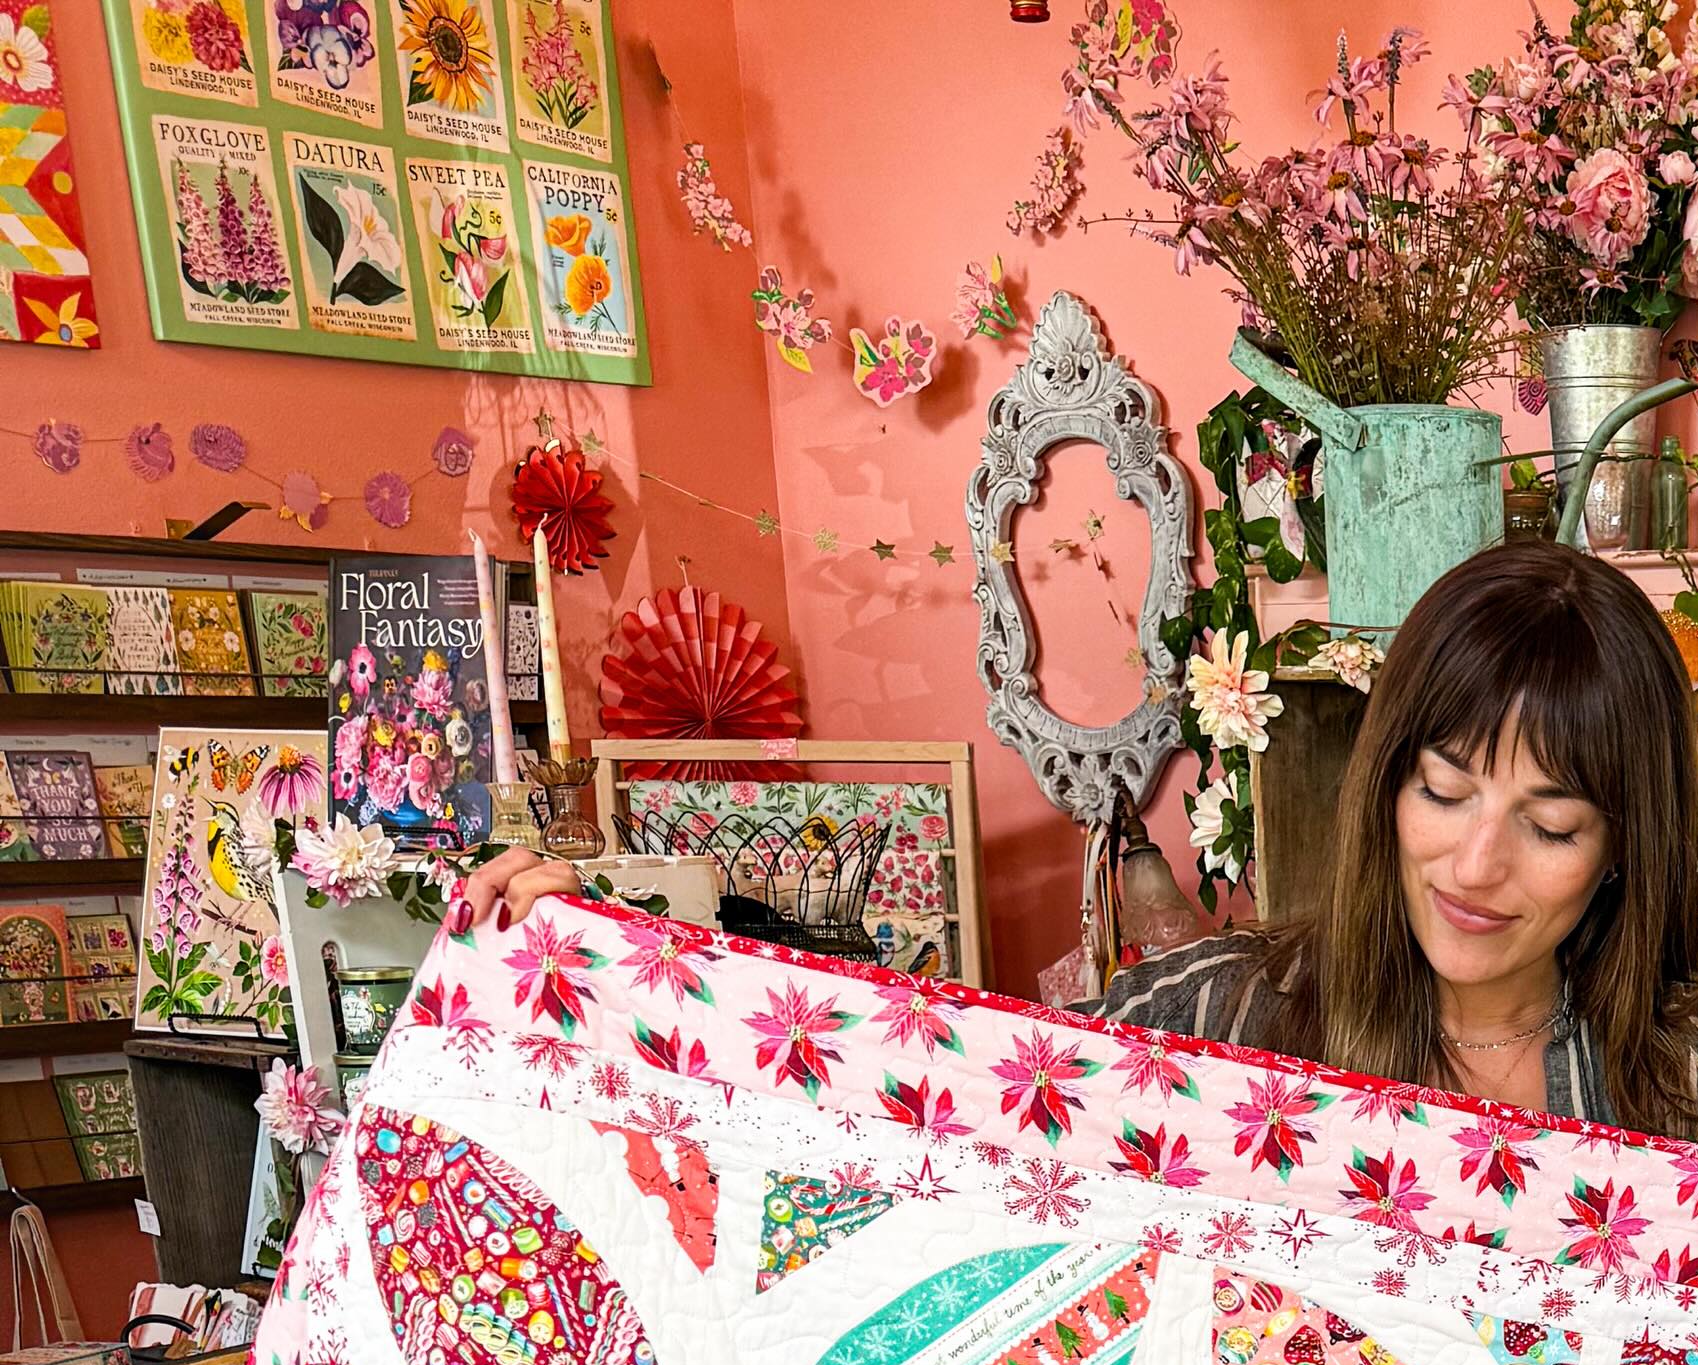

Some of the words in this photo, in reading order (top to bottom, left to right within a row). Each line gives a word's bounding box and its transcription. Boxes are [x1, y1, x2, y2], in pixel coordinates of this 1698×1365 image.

[150, 62, 189, 79] DAISY'S
[191, 70, 217, 83] SEED
[219, 73, 254, 90] HOUSE
[229, 86, 238, 97] IL
[277, 77, 315, 96] DAISY'S
[317, 88, 342, 103] SEED
[345, 97, 377, 114] HOUSE
[353, 107, 362, 119] IL
[407, 110, 443, 126] DAISY'S
[445, 118, 469, 131] SEED
[471, 121, 503, 136] HOUSE
[159, 122, 266, 152] FOXGLOVE
[481, 133, 489, 143] IL
[519, 118, 553, 135] DAISY'S
[555, 127, 577, 142] SEED
[579, 133, 608, 149] HOUSE
[178, 145, 216, 159] QUALITY
[228, 150, 257, 161] MIXED
[294, 138, 385, 174] DATURA
[408, 163, 466, 186] SWEET
[474, 168, 506, 189] PEA
[527, 165, 618, 196] CALIFORNIA
[544, 185, 605, 213] POPPY
[189, 302, 246, 315] MEADOWLAND
[247, 306, 266, 317] SEED
[267, 307, 290, 318] STORE
[311, 305, 368, 321] MEADOWLAND
[369, 312, 388, 324] SEED
[389, 314, 412, 326] STORE
[439, 326, 473, 339] DAISY'S
[475, 328, 499, 340] SEED
[501, 329, 531, 341] HOUSE
[511, 340, 519, 350] IL
[340, 571, 430, 612] Floral
[360, 609, 485, 660] Fantasy
[30, 784, 79, 800] THANK
[40, 799, 73, 814] YOU
[43, 826, 89, 843] MUCH
[947, 1312, 1002, 1360] wonderful
[1034, 1279, 1048, 1301] of
[1046, 1269, 1065, 1287] the
[1067, 1249, 1094, 1278] year
